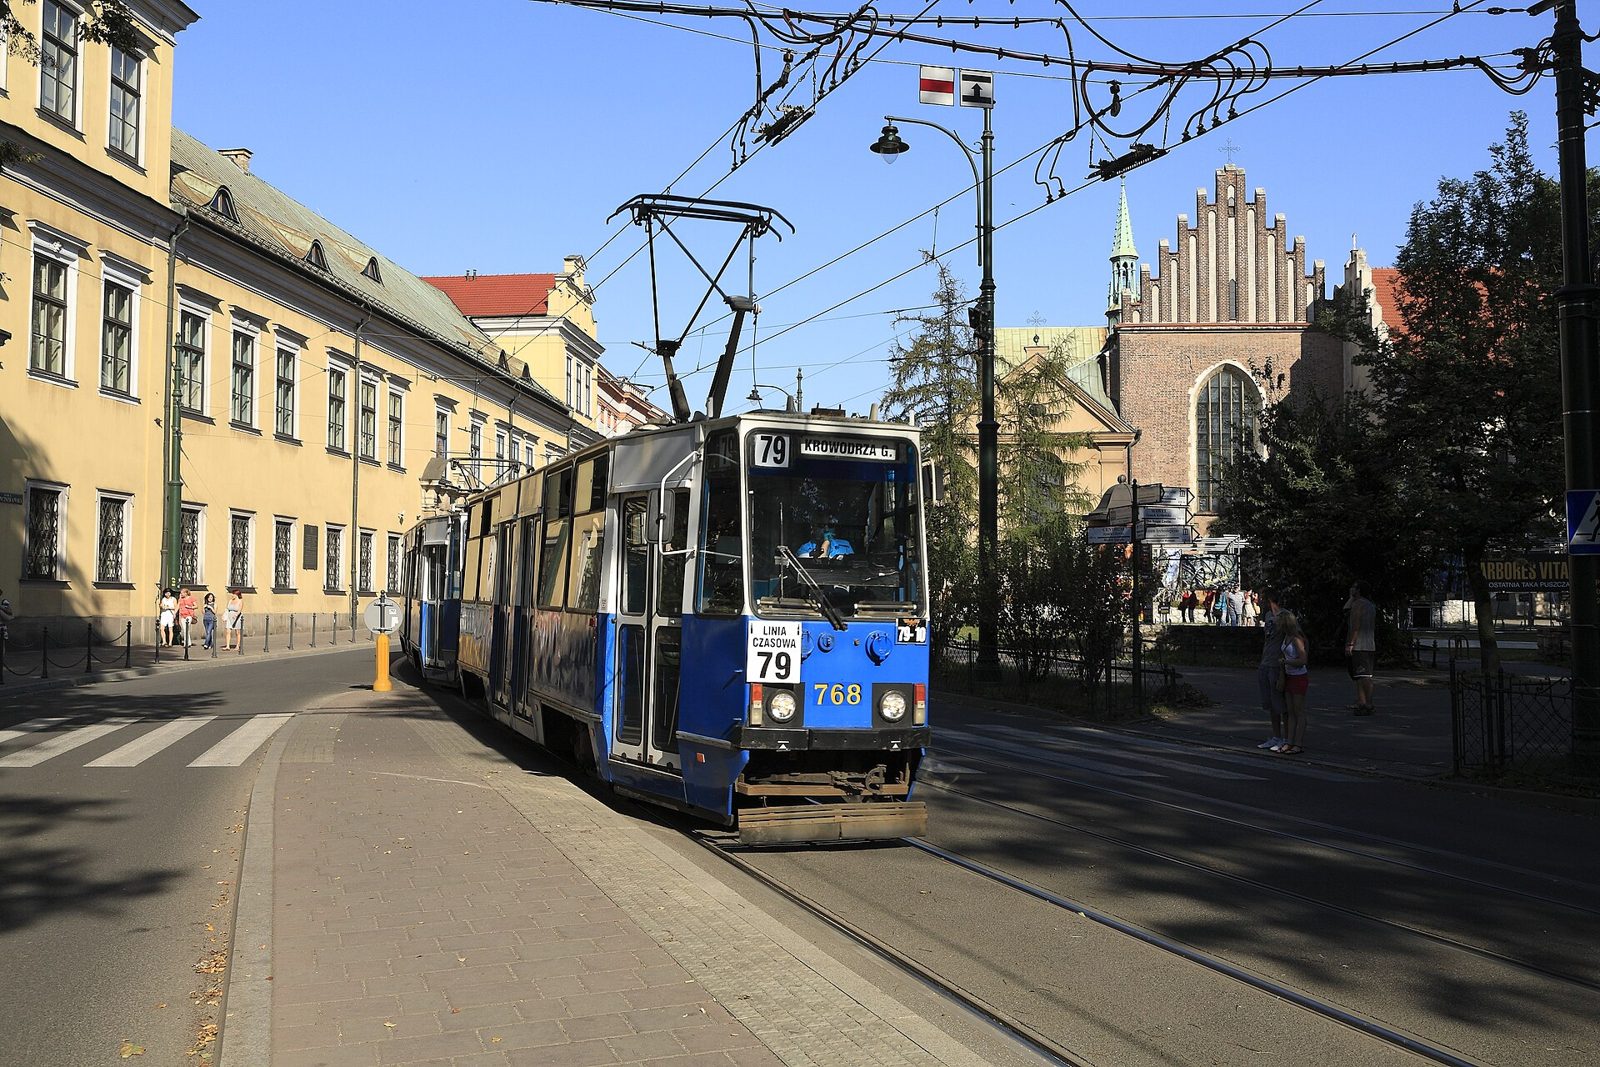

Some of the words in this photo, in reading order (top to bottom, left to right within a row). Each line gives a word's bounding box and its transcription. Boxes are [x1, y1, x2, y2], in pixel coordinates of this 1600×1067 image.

[760, 435, 786, 465] 79
[804, 438, 876, 457] KROWODRZA
[881, 446, 893, 458] G.
[763, 625, 787, 636] LINIA
[897, 626, 927, 642] 79-10
[752, 637, 797, 649] CZASOWA
[757, 651, 791, 680] 79
[814, 683, 862, 706] 768
